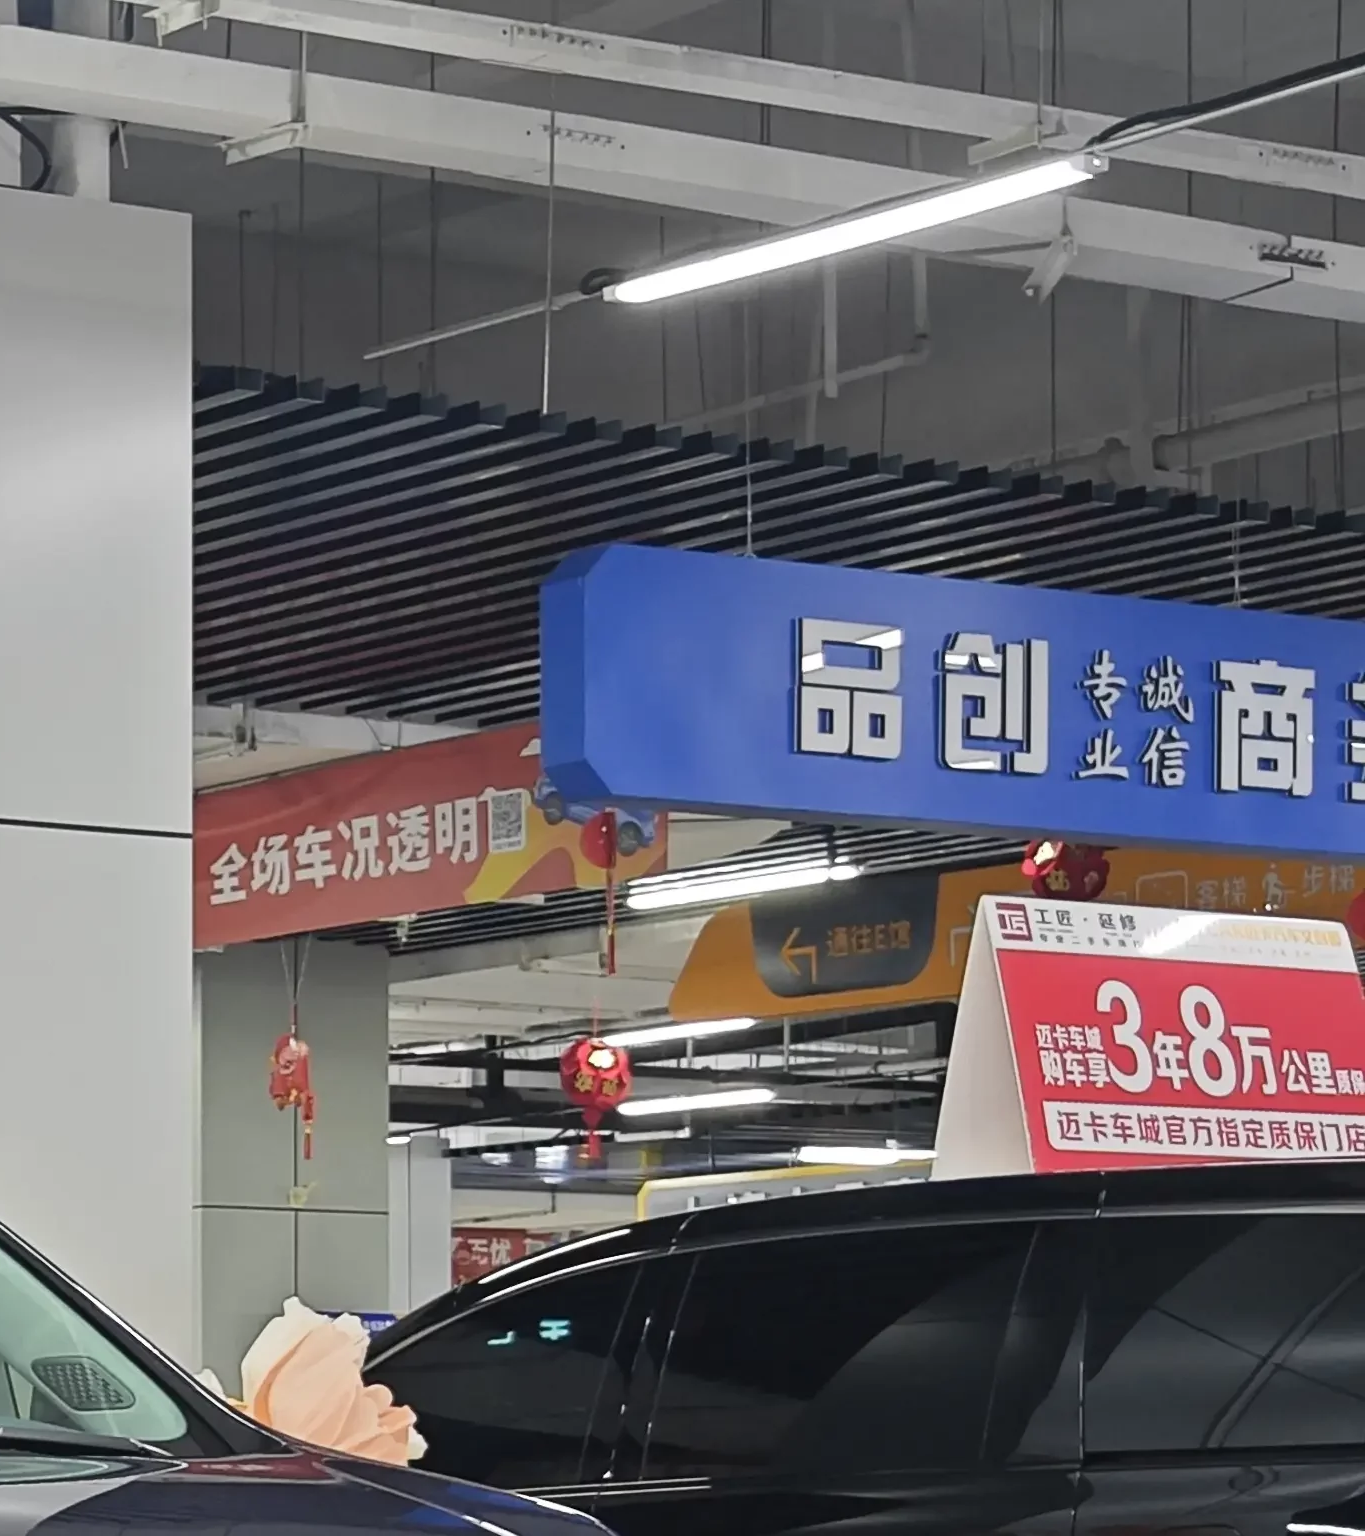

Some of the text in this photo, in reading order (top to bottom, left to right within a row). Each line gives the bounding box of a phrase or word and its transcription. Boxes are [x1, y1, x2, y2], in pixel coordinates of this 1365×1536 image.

[795, 616, 1049, 776] 品创
[1213, 658, 1365, 803] 商
[208, 796, 479, 906] 全场车况透明
[826, 919, 911, 958] 通往E馆
[1035, 1023, 1103, 1052] 迈卡车城
[1040, 1049, 1111, 1088] 购车享
[1057, 1109, 1365, 1153] 迈卡车城官方指定质保门店
